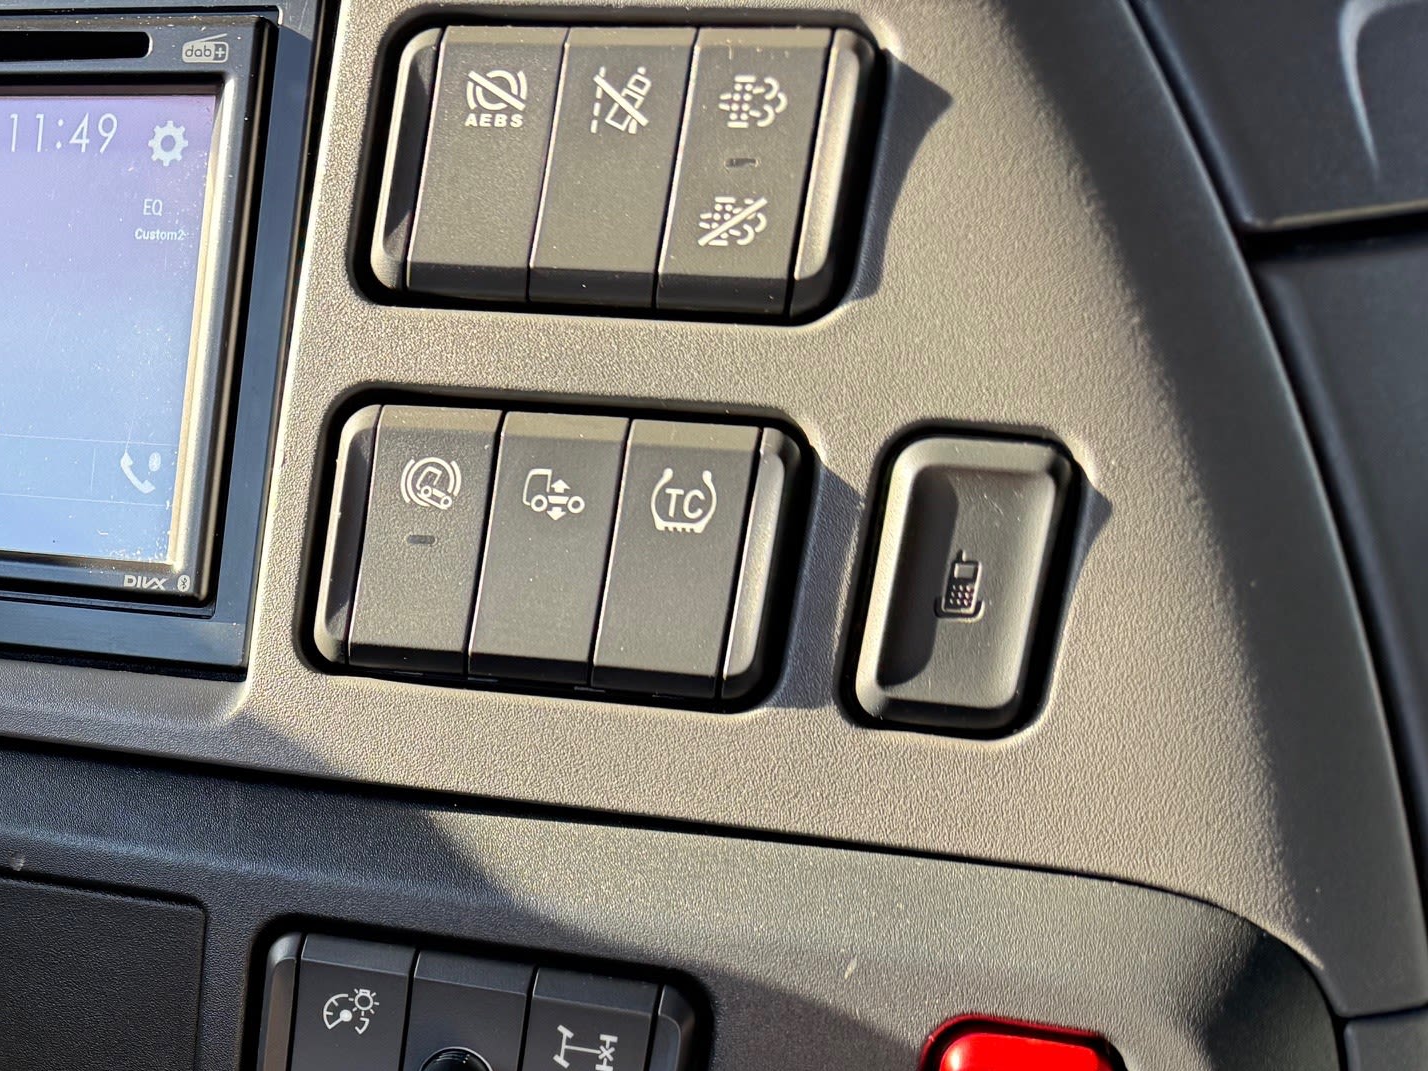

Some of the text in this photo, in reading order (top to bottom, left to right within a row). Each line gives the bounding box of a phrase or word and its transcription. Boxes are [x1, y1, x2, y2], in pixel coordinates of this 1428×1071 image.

[184, 43, 227, 59] dab+
[464, 112, 525, 129] AEBS
[9, 112, 118, 153] 11:49
[143, 198, 163, 216] EQ
[134, 227, 186, 241] Custom2
[665, 487, 705, 519] TC
